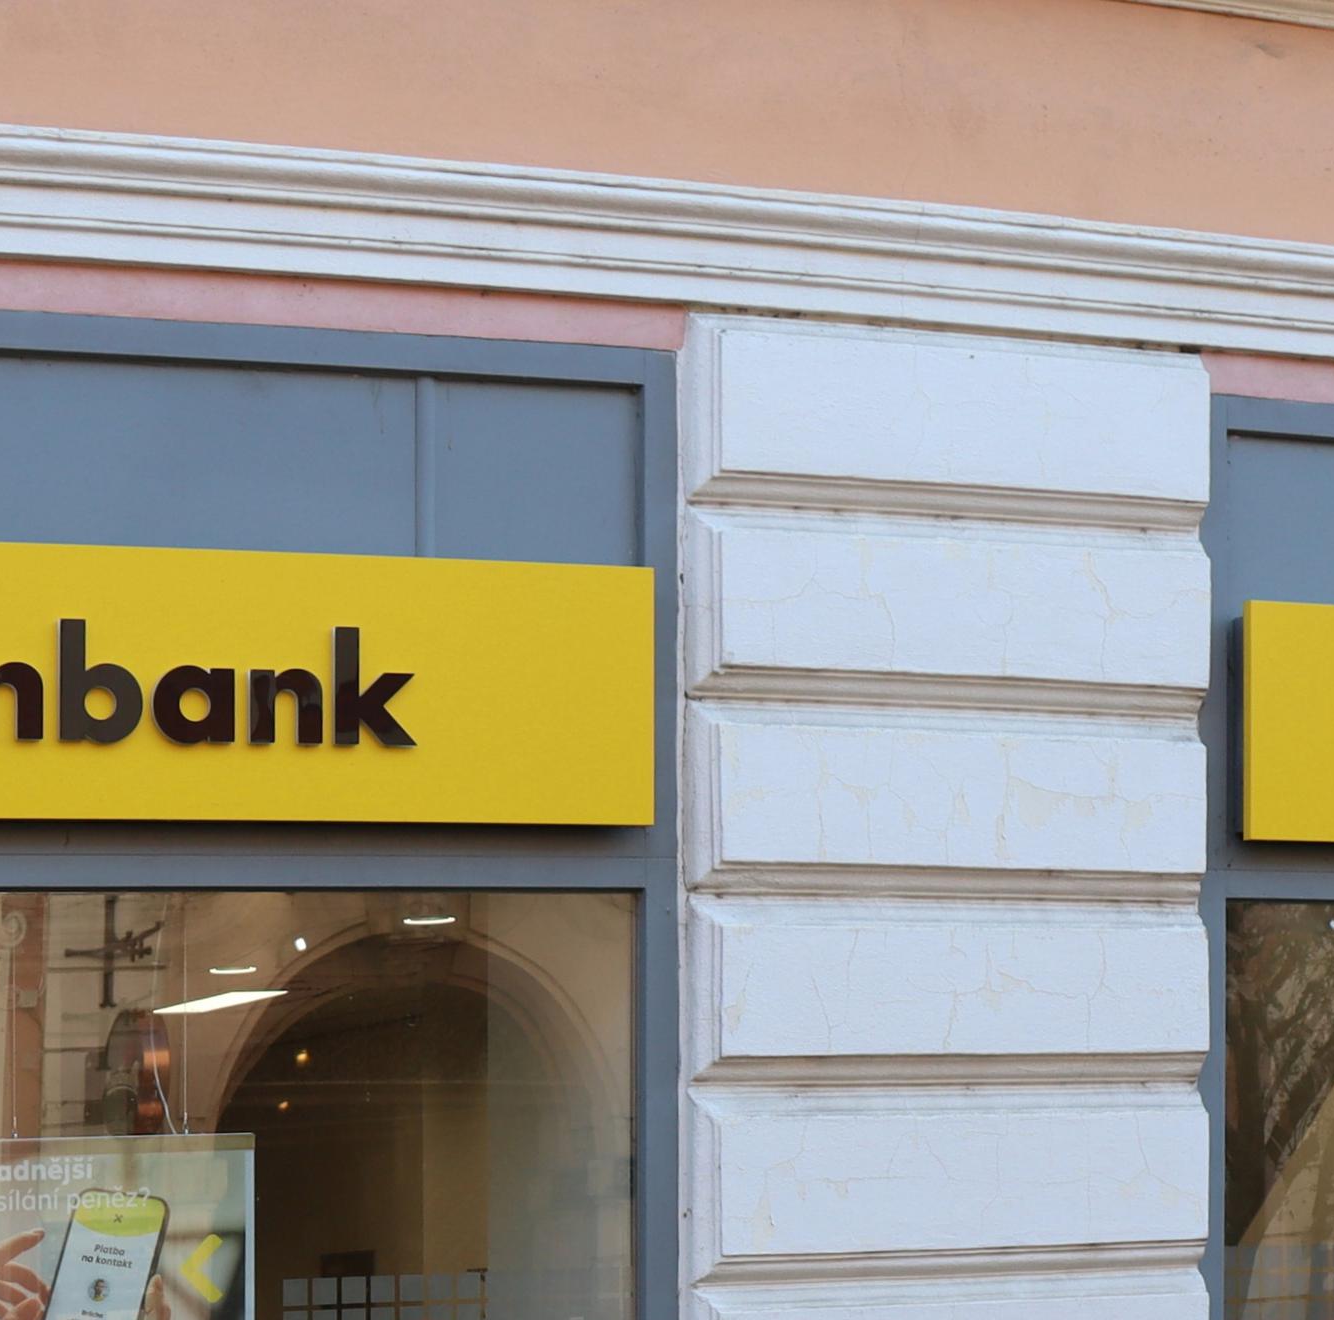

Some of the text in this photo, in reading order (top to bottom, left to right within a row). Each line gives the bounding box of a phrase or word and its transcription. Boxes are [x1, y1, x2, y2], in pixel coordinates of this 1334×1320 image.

[66, 1186, 151, 1214] peněz?
[94, 1242, 126, 1256] Platba
[81, 1254, 134, 1269] na kontakt
